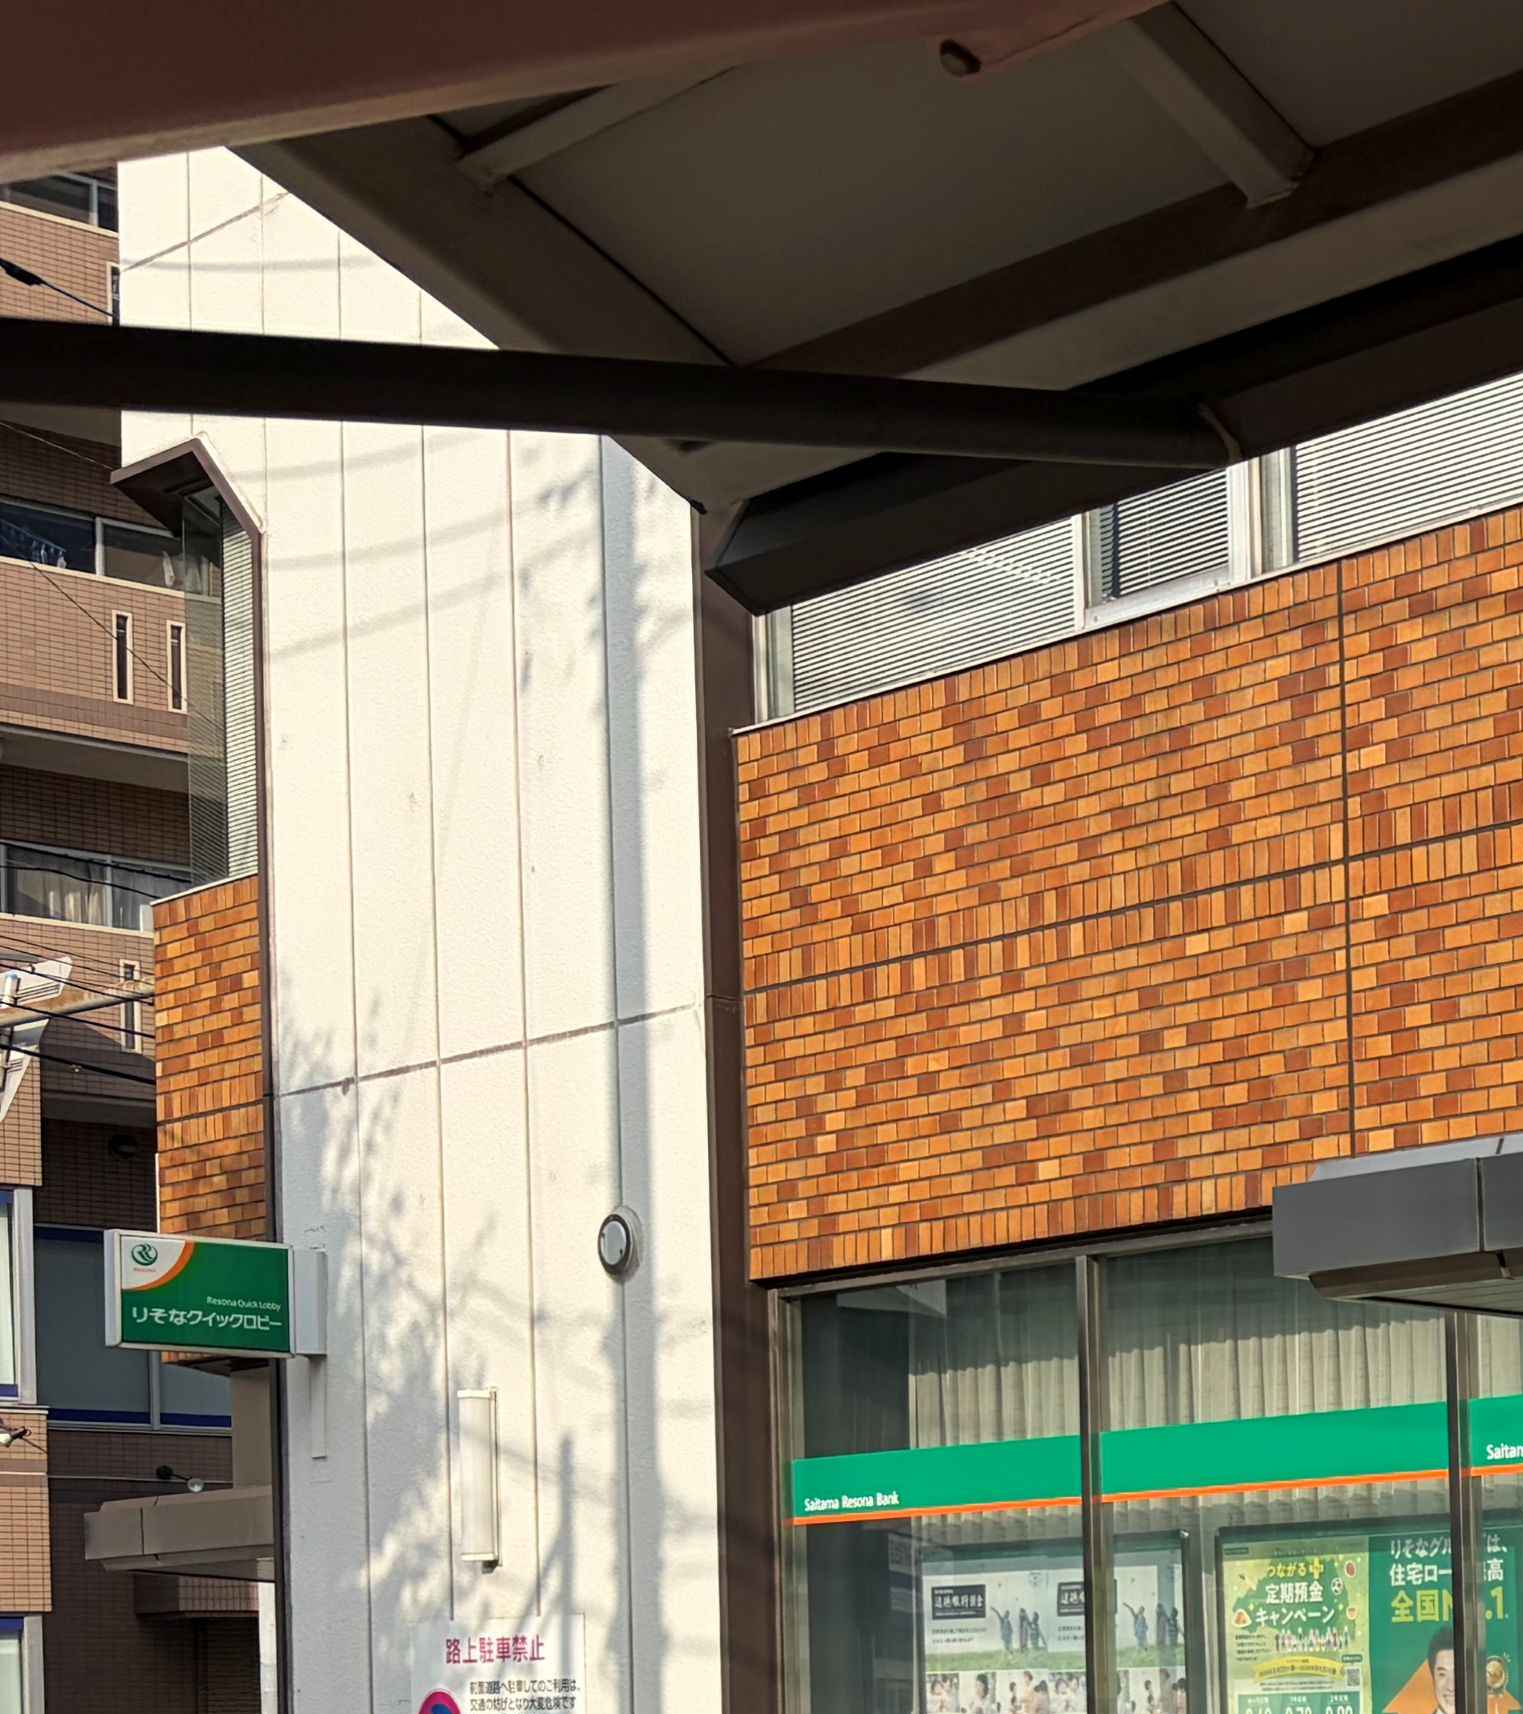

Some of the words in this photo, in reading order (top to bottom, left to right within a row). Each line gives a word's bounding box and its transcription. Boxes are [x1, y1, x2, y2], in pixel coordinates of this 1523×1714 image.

[206, 1296, 237, 1307] Resona
[238, 1299, 258, 1309] Quick
[259, 1301, 282, 1312] Lobby
[132, 1307, 282, 1330] りそなクイックロビー
[805, 1497, 839, 1512] Saitama
[842, 1494, 873, 1508] Resona
[876, 1491, 899, 1506] Bank
[1391, 1534, 1508, 1560] りそなグルは、
[1267, 1562, 1307, 1577] つながる
[1390, 1558, 1504, 1586] 住宅ロー高
[1266, 1581, 1323, 1604] 定期預金
[1255, 1606, 1335, 1627] キャンペーン
[446, 1634, 545, 1664] 路上駐車禁止
